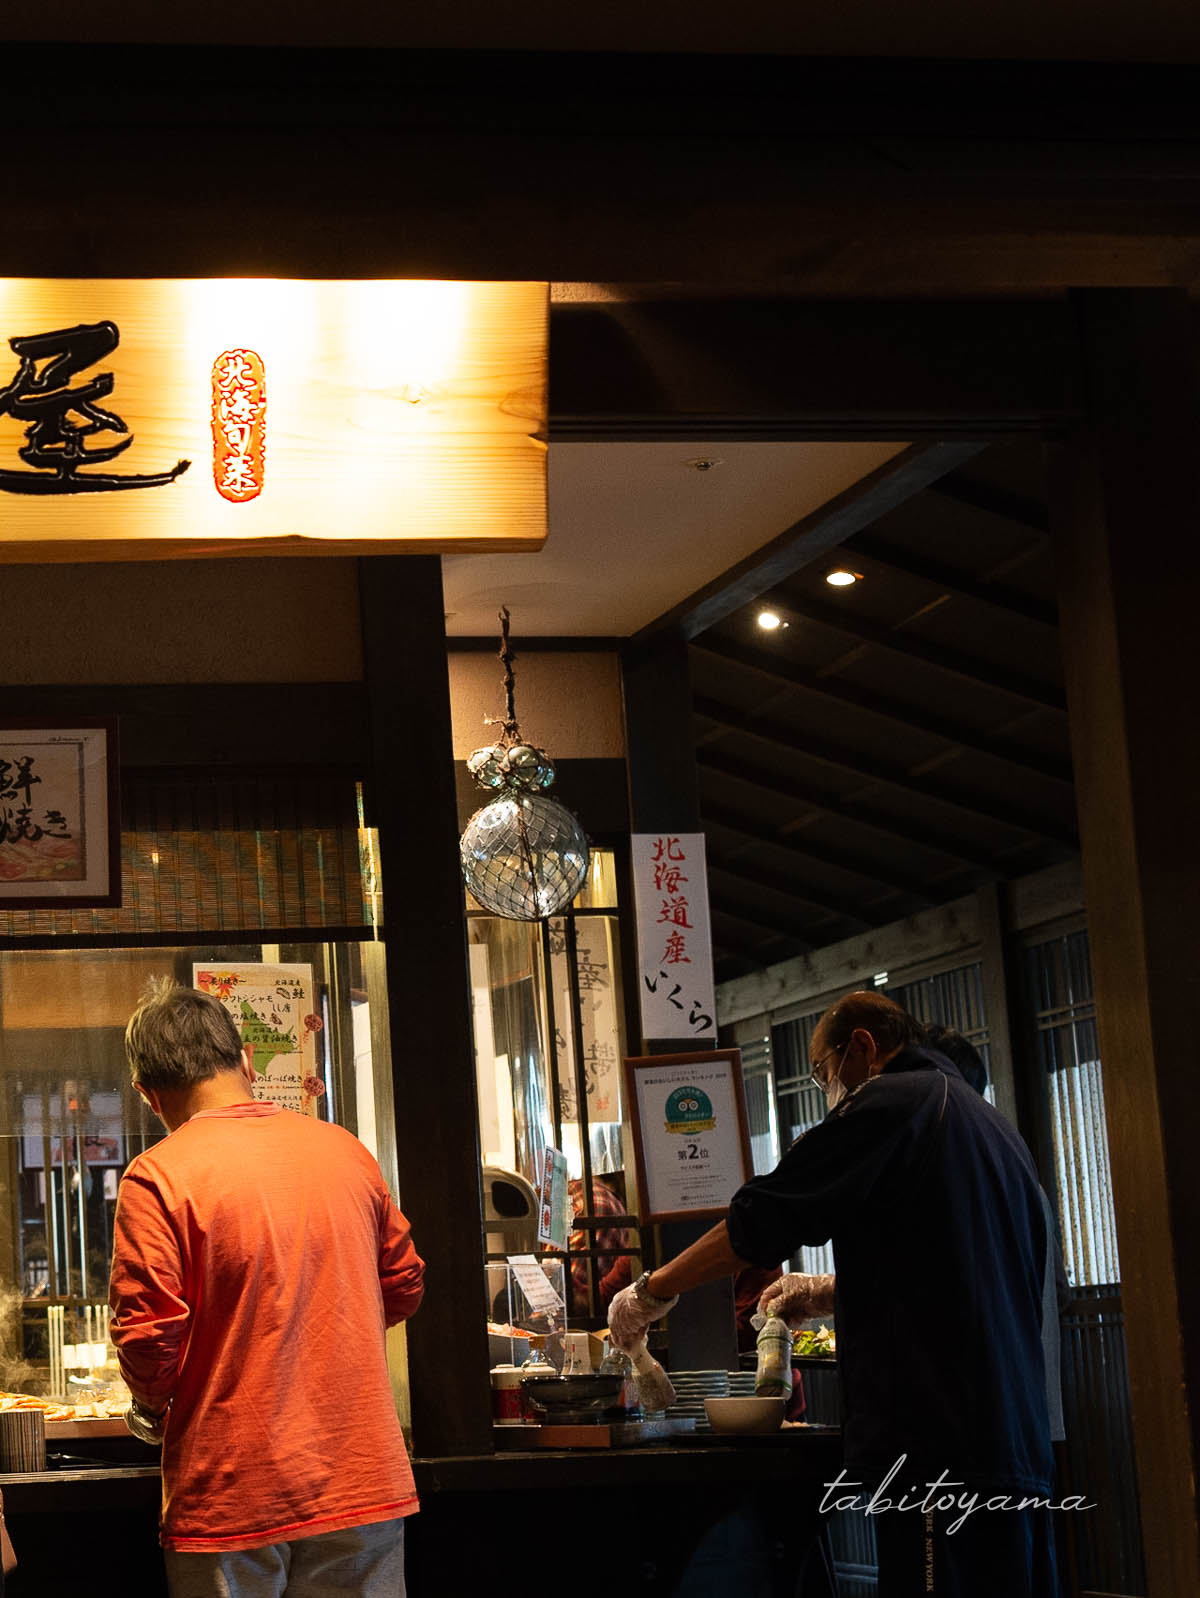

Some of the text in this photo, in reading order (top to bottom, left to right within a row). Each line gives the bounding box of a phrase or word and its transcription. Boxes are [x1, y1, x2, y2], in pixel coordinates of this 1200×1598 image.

[651, 836, 694, 965] 北海道産
[644, 970, 713, 1034] いくら
[677, 1144, 710, 1161] 第2位
